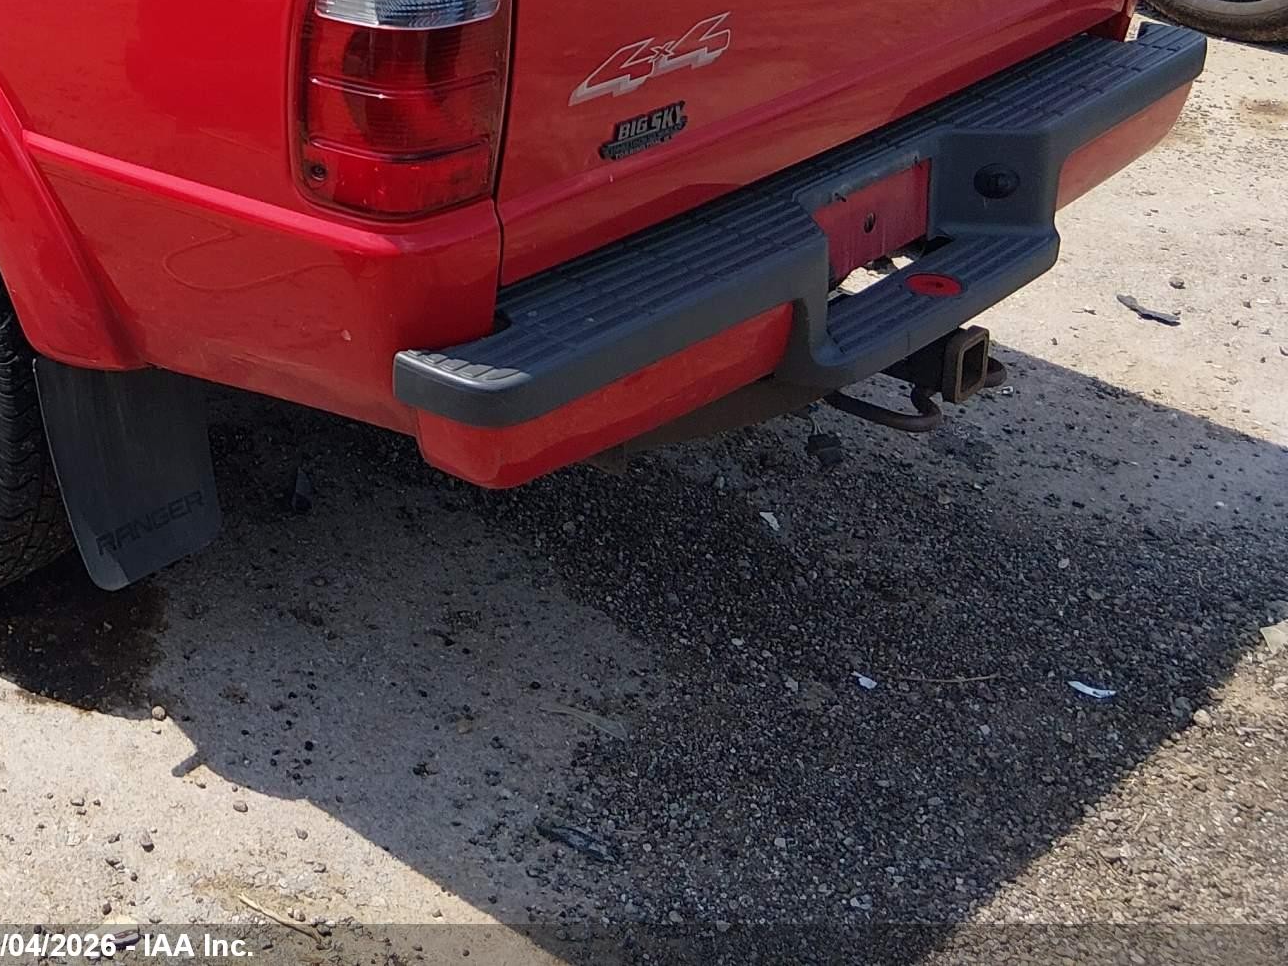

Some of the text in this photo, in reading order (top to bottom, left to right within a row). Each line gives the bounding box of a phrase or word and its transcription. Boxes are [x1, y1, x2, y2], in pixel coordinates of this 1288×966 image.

[617, 116, 649, 141] BIG
[650, 104, 684, 132] SKY
[95, 490, 205, 555] RANGER
